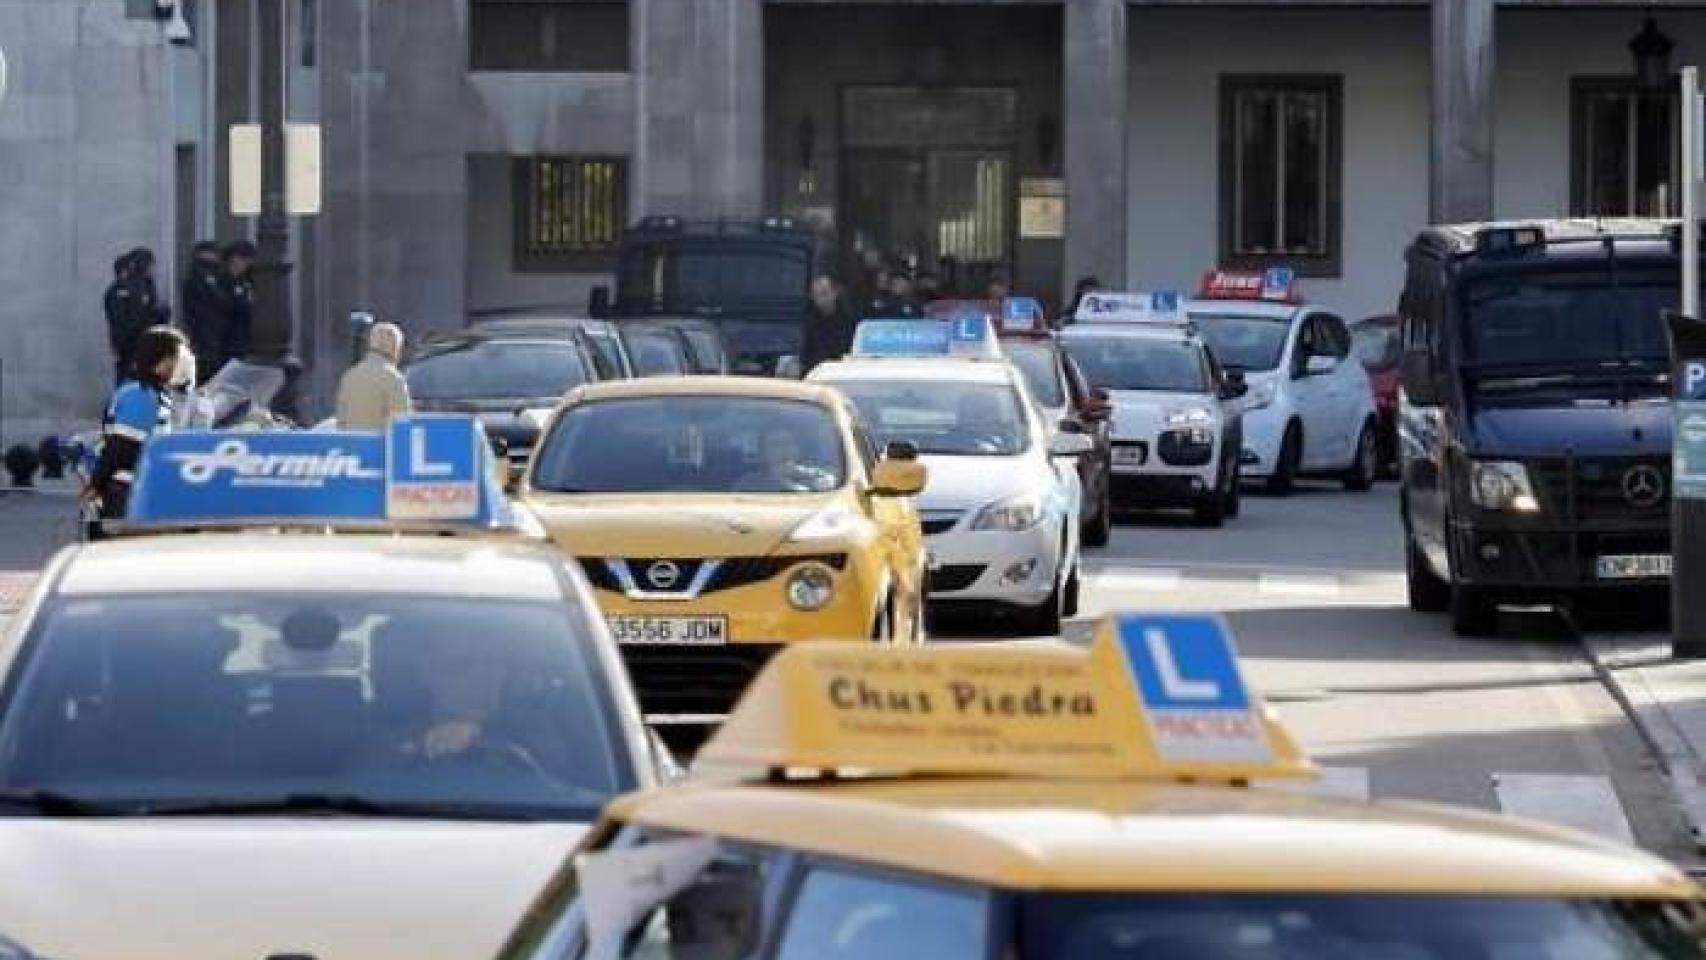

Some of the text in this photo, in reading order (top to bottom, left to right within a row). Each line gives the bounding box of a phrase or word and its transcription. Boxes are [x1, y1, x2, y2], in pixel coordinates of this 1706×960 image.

[961, 309, 976, 337] L
[1686, 363, 1705, 393] P
[411, 426, 453, 475] L
[1143, 626, 1220, 699] L
[829, 677, 1096, 716] Chus Piedra
